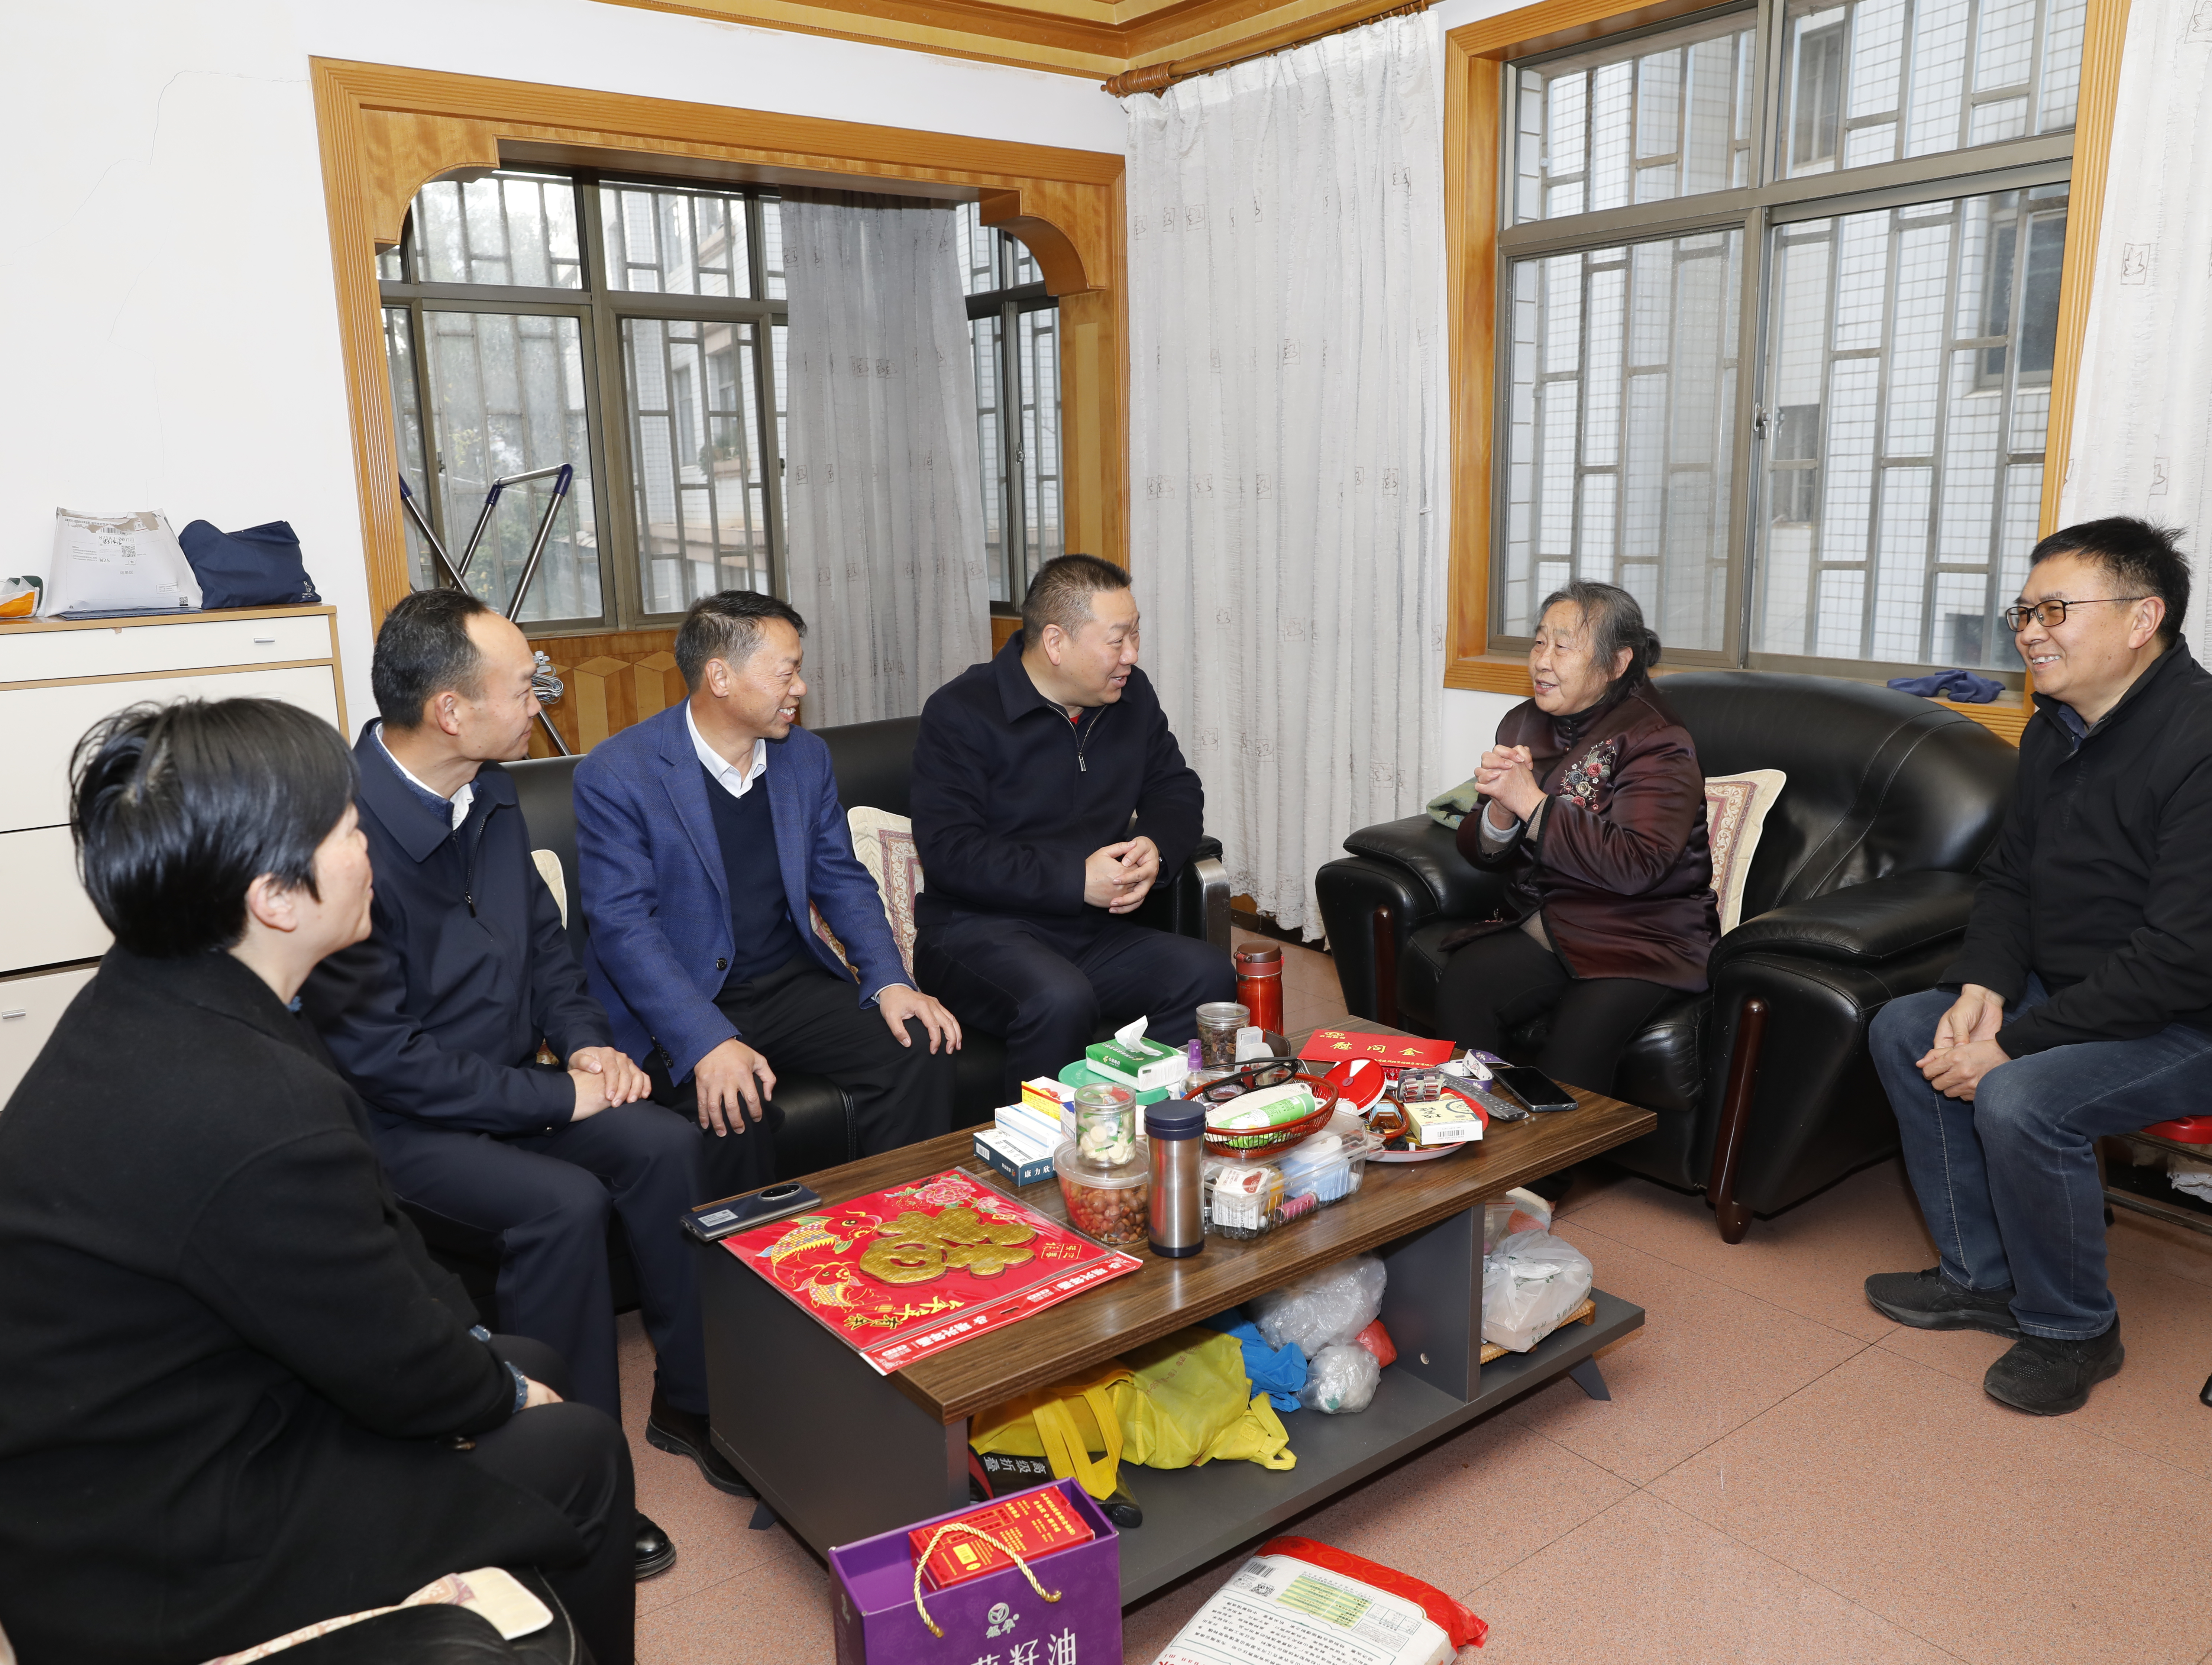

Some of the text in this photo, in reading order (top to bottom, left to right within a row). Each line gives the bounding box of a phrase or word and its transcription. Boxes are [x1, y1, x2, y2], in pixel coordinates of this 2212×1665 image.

[1330, 1042, 1424, 1056] 慰问金
[859, 1207, 1037, 1284] 福
[843, 1296, 965, 1331] 年年有余
[983, 1457, 1046, 1474] 高级折叠
